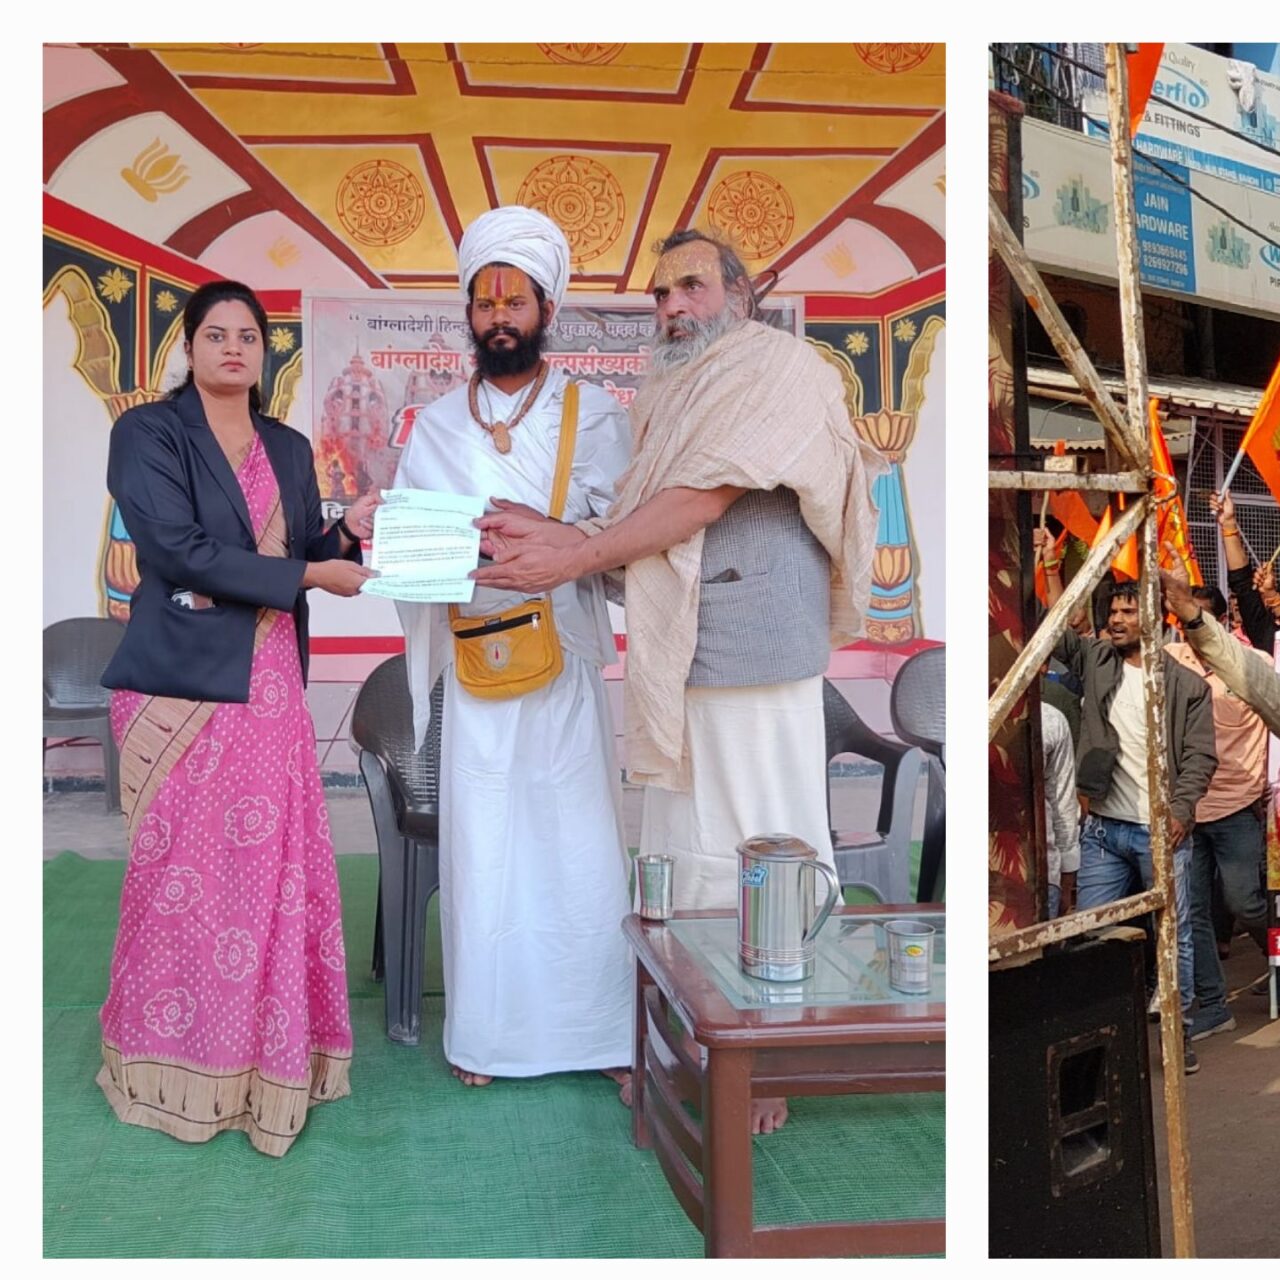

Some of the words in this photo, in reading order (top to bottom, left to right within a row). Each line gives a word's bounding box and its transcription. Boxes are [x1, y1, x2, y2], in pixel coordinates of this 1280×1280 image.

[1153, 79, 1201, 108] erflo
[1154, 112, 1201, 139] FITTINGS
[1143, 191, 1169, 213] JAIN
[1136, 211, 1190, 241] ARDWARE
[367, 314, 434, 333] बांग्लादेशी
[370, 344, 462, 371] बांग्लादेश
